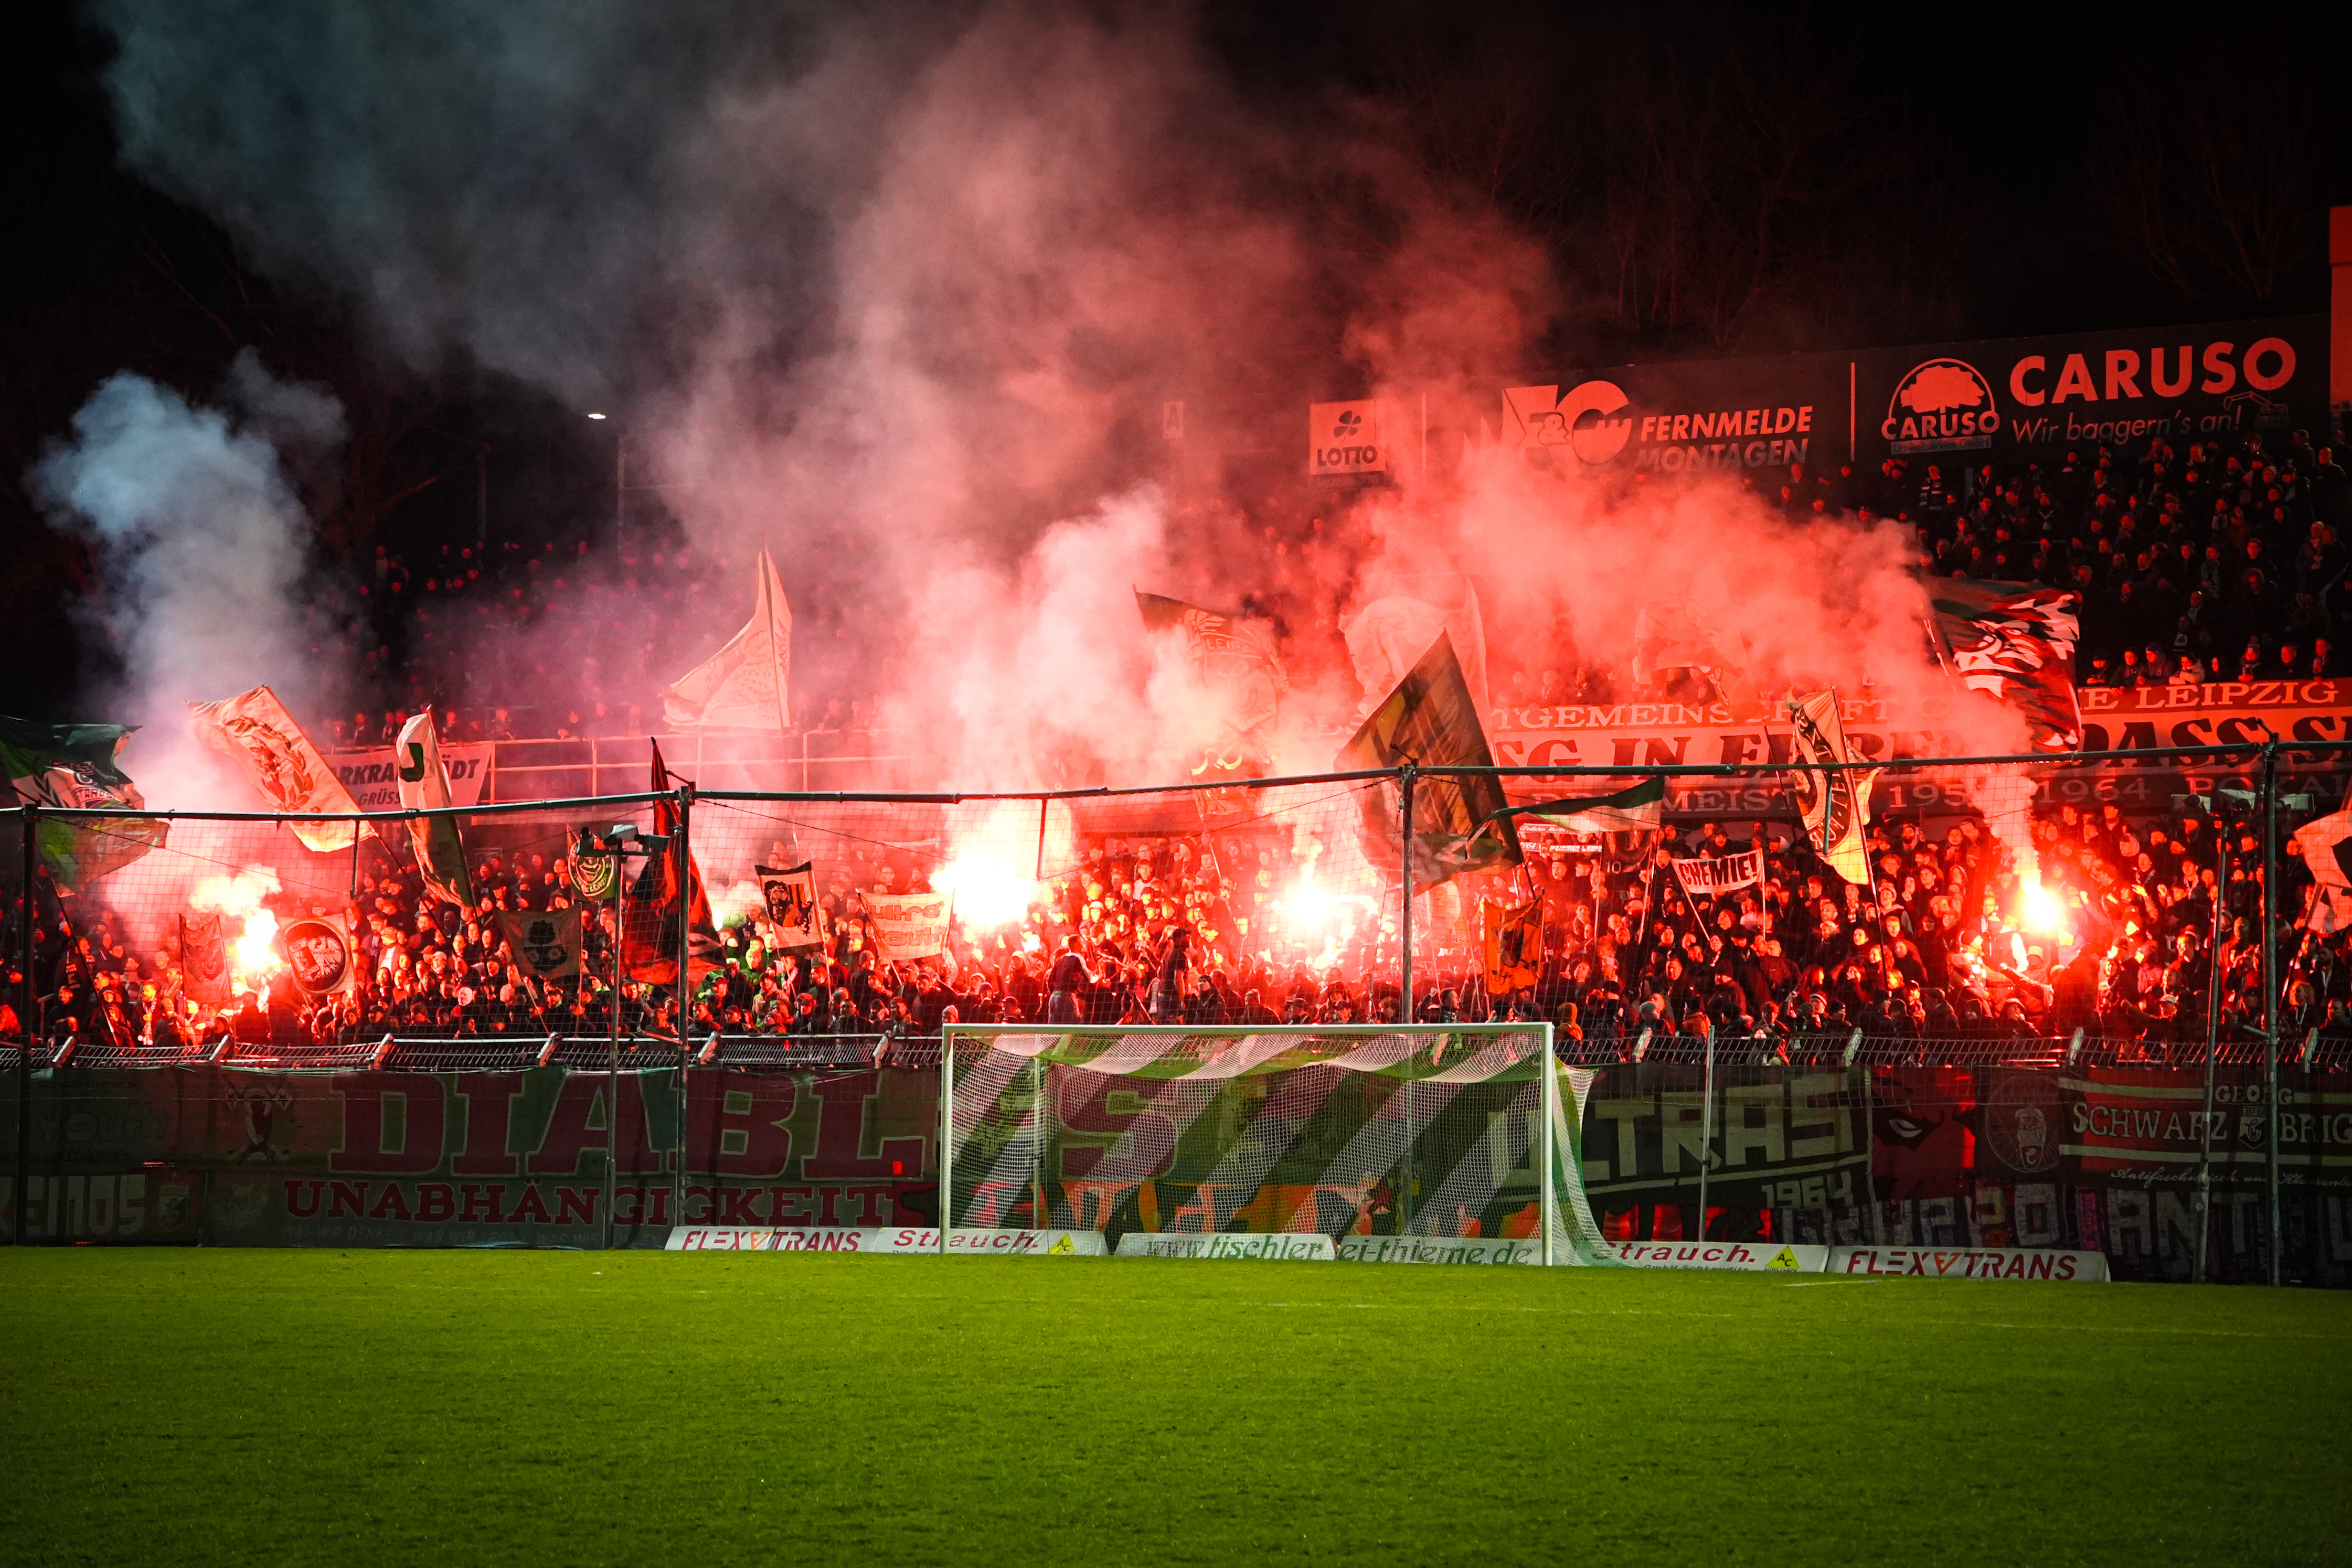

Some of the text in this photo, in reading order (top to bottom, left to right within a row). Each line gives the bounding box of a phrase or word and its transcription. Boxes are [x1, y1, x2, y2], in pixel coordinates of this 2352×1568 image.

[2010, 337, 2296, 407] CARUSO
[1641, 406, 1813, 442] FERNMELDE
[1881, 410, 2000, 441] CARUSO
[2013, 418, 2056, 444] Wir
[2199, 405, 2242, 433] an!
[1317, 445, 1378, 466] LOTTO
[1634, 438, 1810, 474] MONTAGEN
[2135, 681, 2339, 709] LEIPZIG
[1606, 735, 1692, 781] IN
[2039, 776, 2152, 803] 1964
[1605, 861, 1622, 874] 10
[1679, 852, 1757, 887] CHEMIE!
[2215, 1084, 2294, 1106] GEOG
[2072, 1101, 2228, 1142] SCHWARZ
[283, 1179, 893, 1228] UNABHÄNGIGKEIT
[1761, 1169, 1853, 1208] 1964
